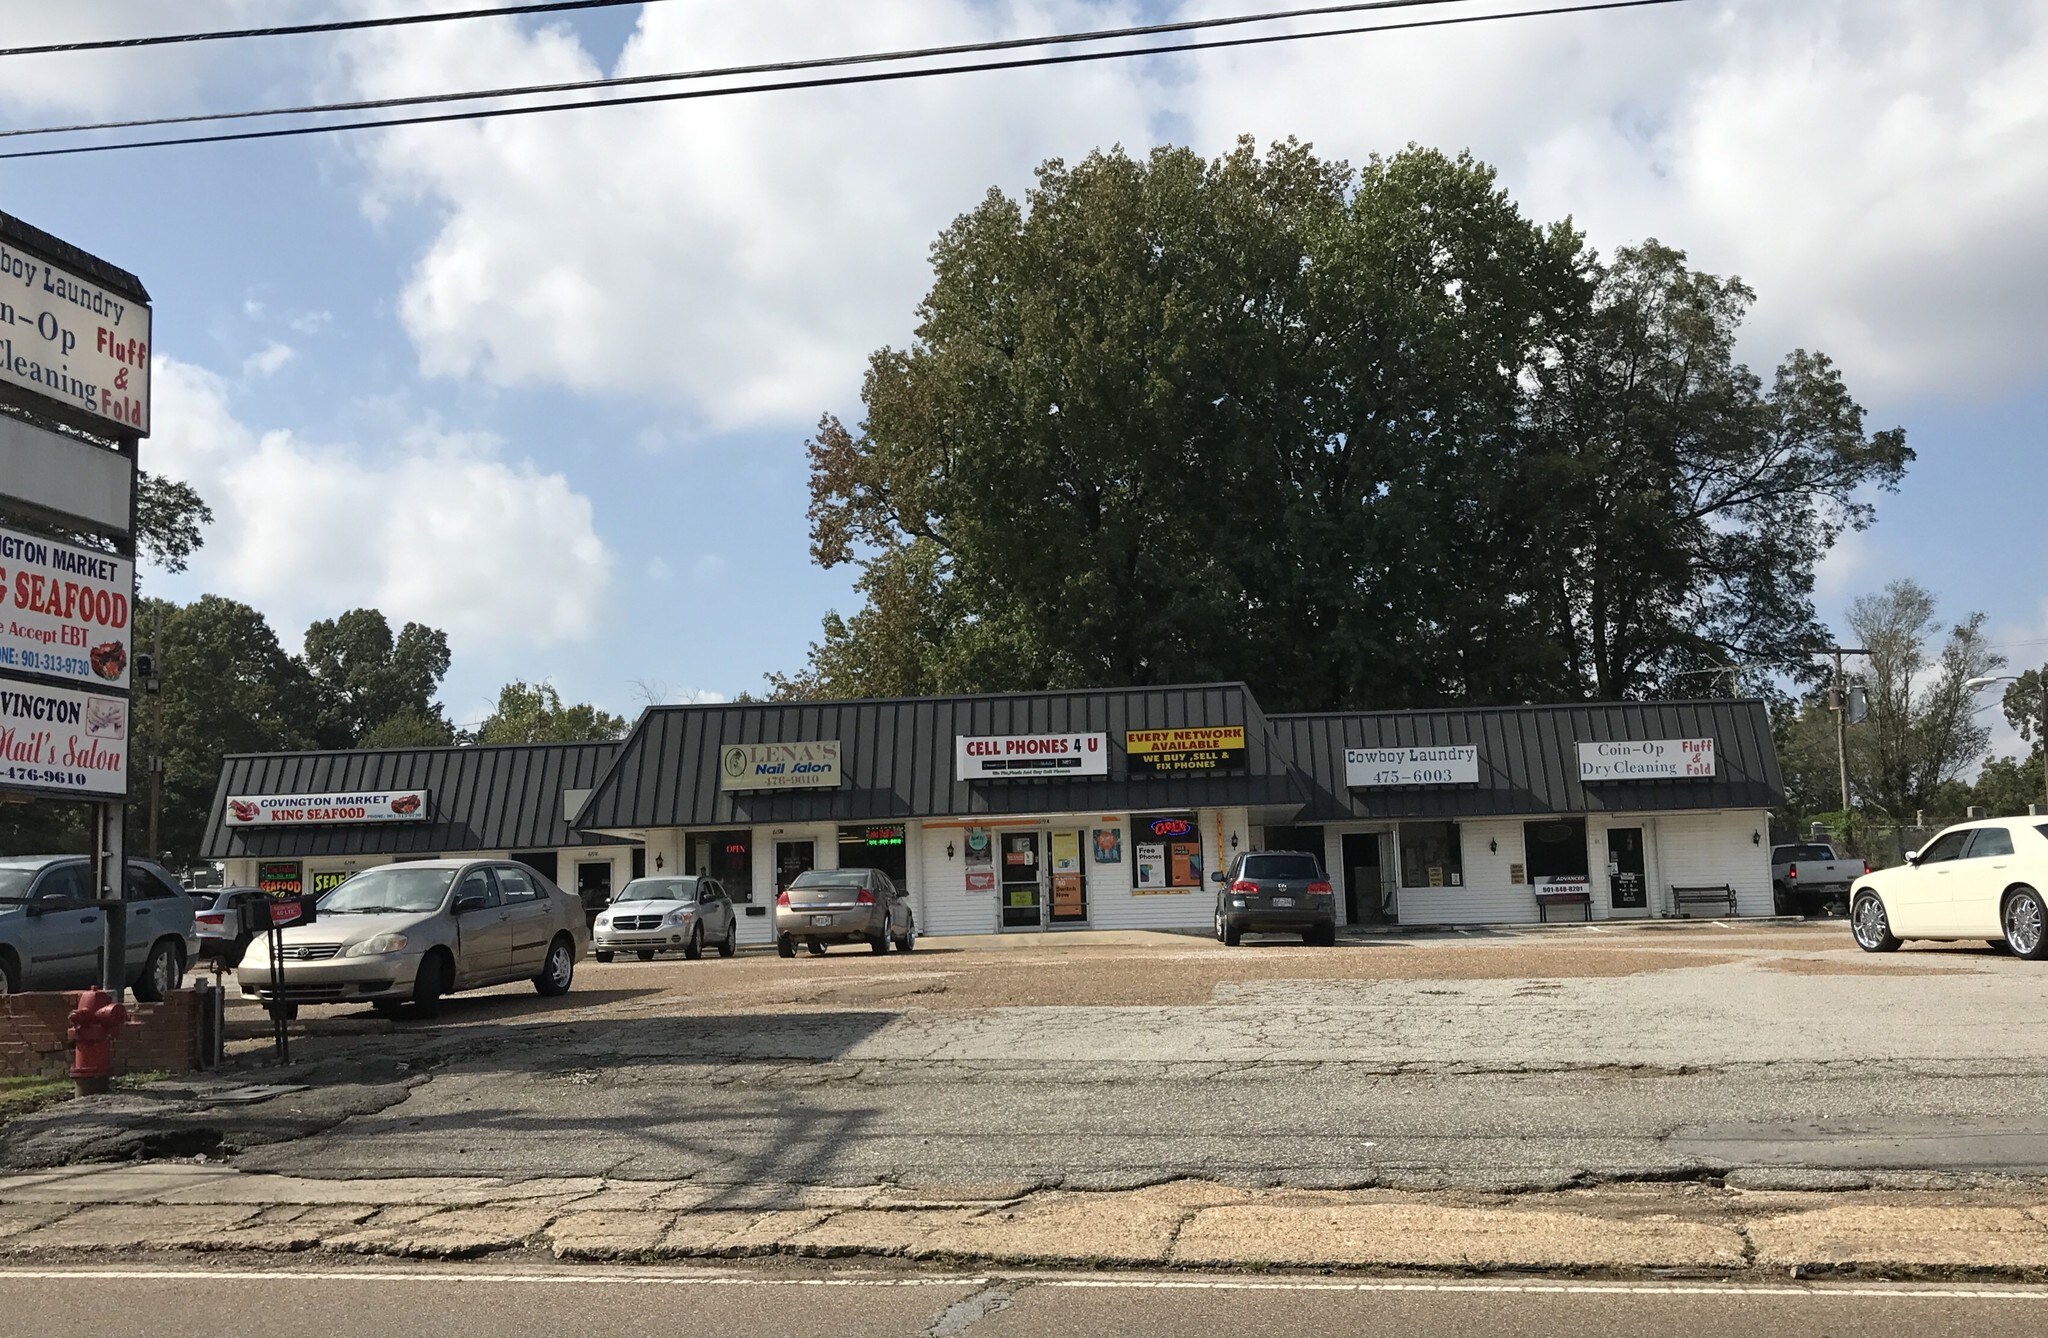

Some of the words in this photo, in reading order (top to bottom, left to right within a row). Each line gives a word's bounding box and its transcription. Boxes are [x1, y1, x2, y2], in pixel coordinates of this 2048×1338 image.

[43, 267, 124, 326] Laundry
[97, 326, 147, 369] Fluff
[0, 339, 98, 411] leaning
[114, 367, 129, 391] &
[101, 388, 142, 427] Fold
[53, 549, 118, 582] MARKET
[14, 571, 128, 629] SEAFOOD
[9, 621, 57, 645] Accept
[61, 624, 90, 648] EBT
[22, 650, 90, 677] 901-313-9730
[1128, 732, 1169, 743] EVERY
[1174, 729, 1242, 740] NETWORK
[62, 735, 121, 771] Salon
[751, 743, 837, 763] LENA'S
[966, 741, 1001, 756] CELL
[1006, 739, 1068, 755] PHONES
[1073, 738, 1081, 752] 4
[1087, 737, 1098, 752] U
[1151, 740, 1220, 751] AVAILABLE
[1598, 742, 1664, 757] Coin-Op
[1682, 740, 1712, 753] Fluff
[1143, 755, 1160, 763] WE
[1164, 753, 1186, 762] BUY
[1221, 751, 1230, 759] &
[1347, 750, 1405, 764] Cowboy
[1409, 747, 1474, 761] Laundry
[1692, 753, 1701, 763] &
[755, 763, 785, 775] Nail
[791, 761, 832, 773] Salon
[1174, 760, 1216, 769] PHONES
[1582, 762, 1611, 777] Dry
[1614, 760, 1677, 774] Cleaning
[1686, 763, 1711, 775] Fold
[1373, 769, 1452, 783] 475-6003
[261, 797, 331, 808] COVINGTON
[336, 795, 389, 805] MARKET
[272, 809, 303, 821] KING
[307, 807, 365, 819] SEAFOOD
[1155, 820, 1187, 835] OPEN
[726, 845, 745, 853] OPEN
[260, 881, 301, 894] SEAFOOD
